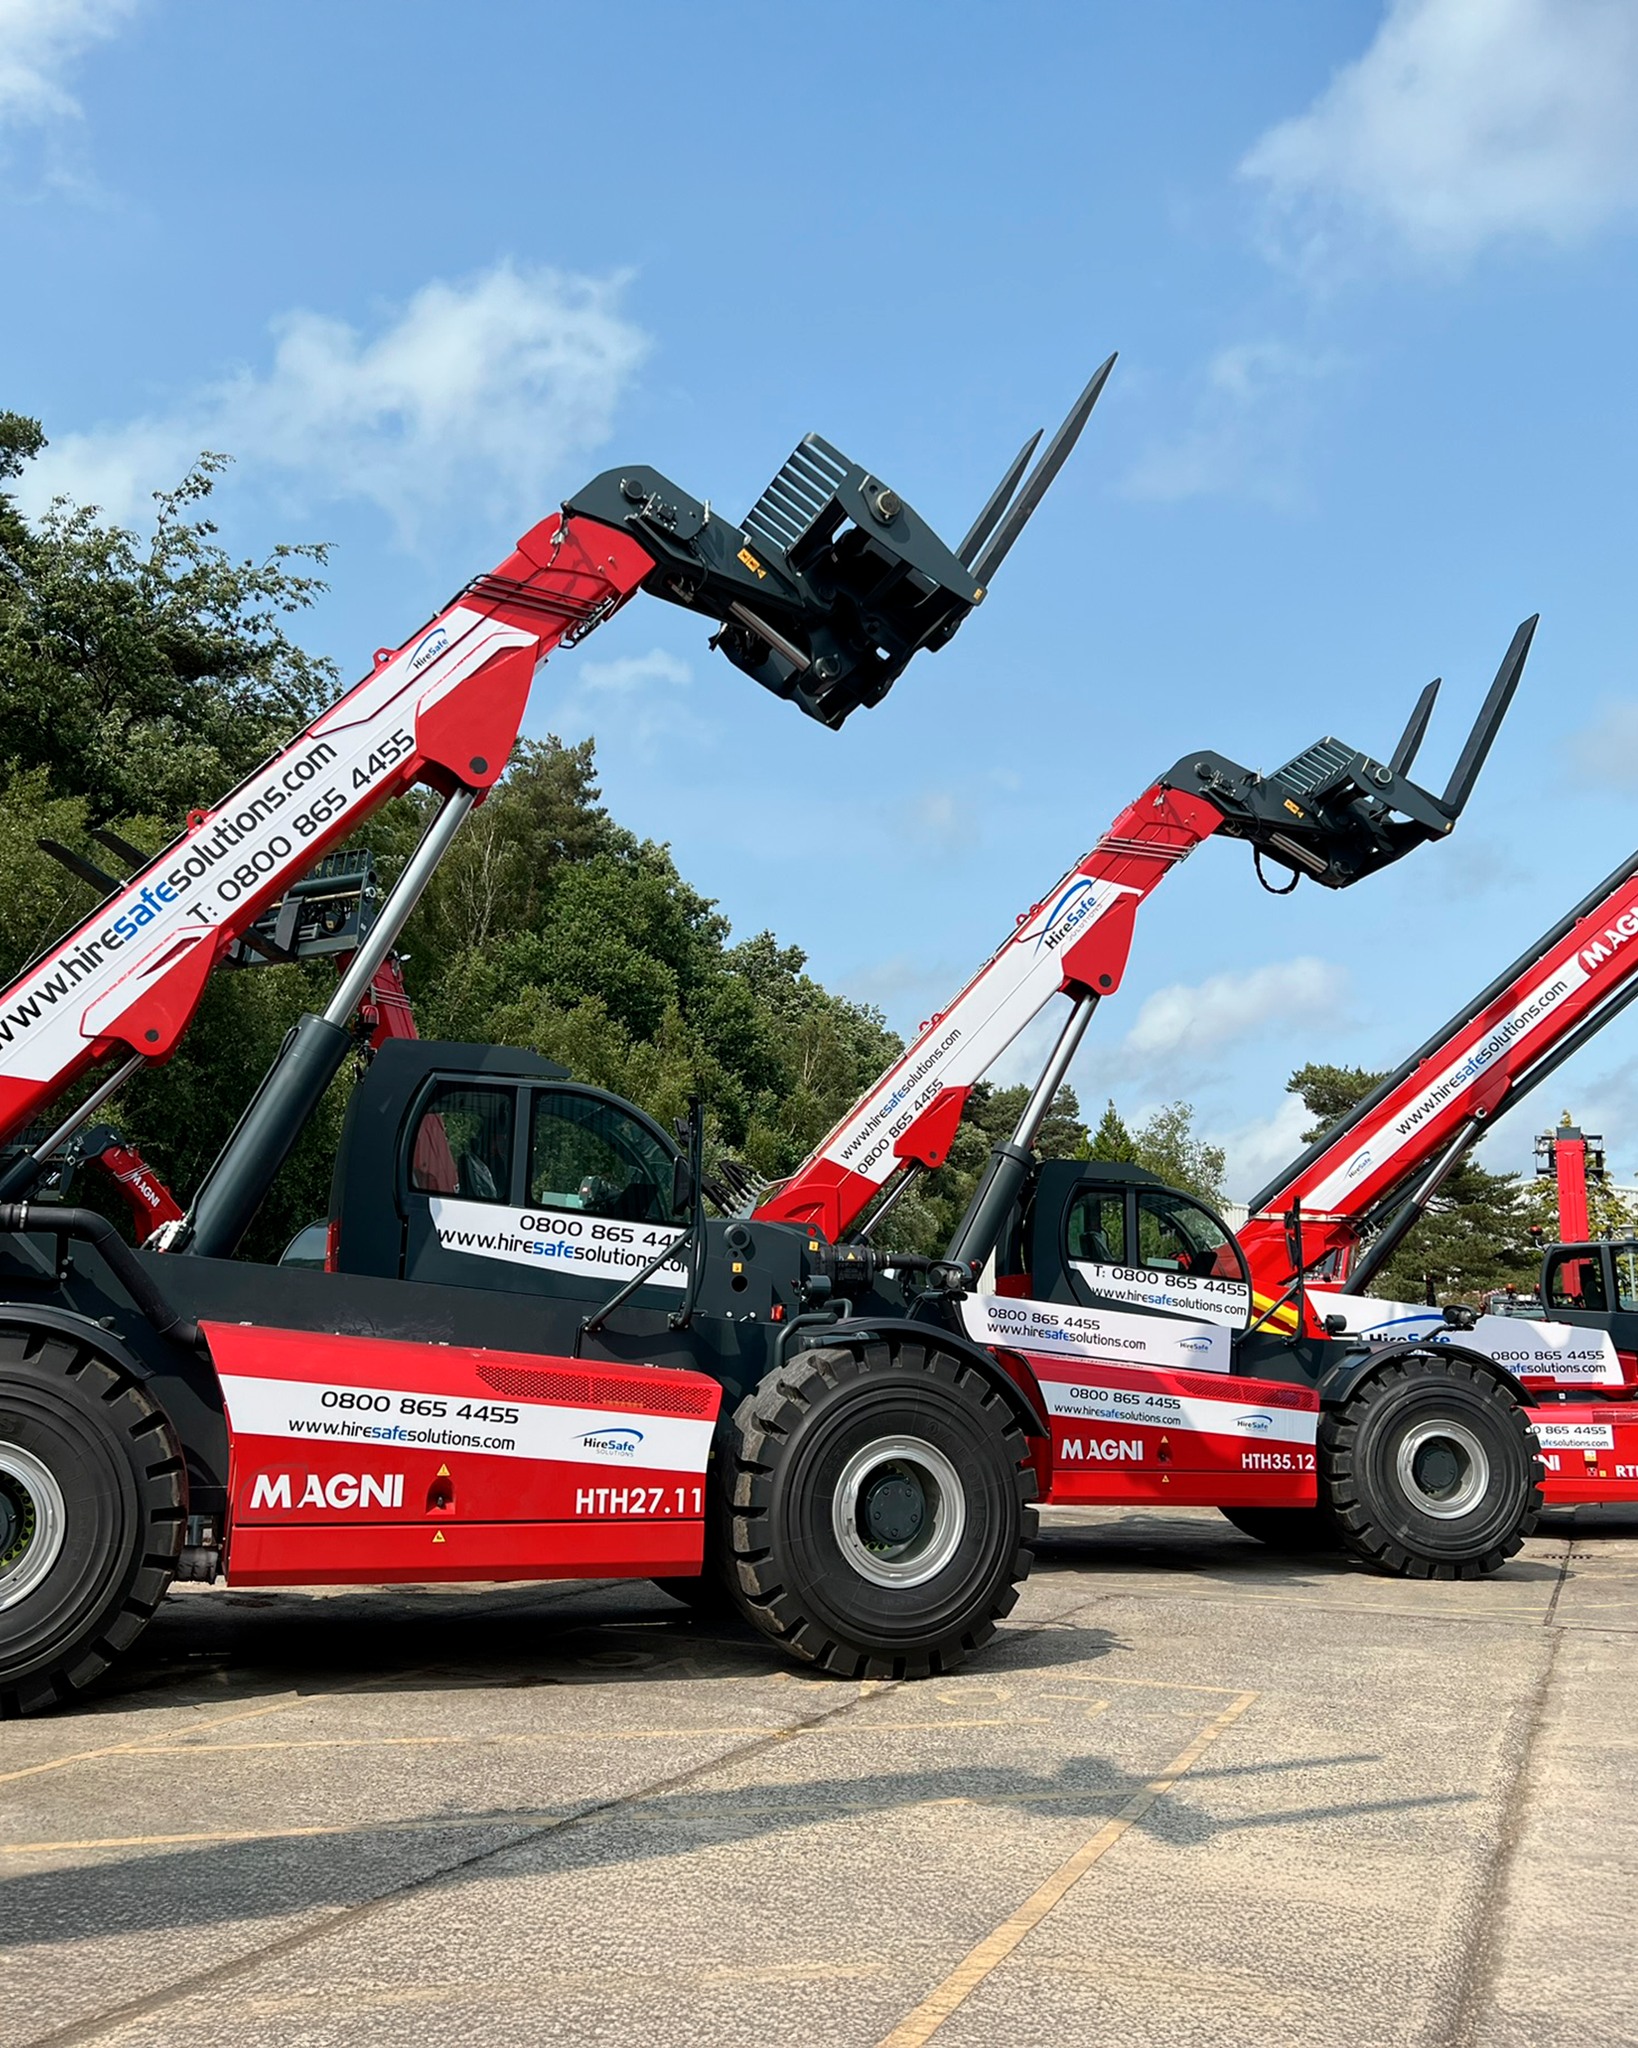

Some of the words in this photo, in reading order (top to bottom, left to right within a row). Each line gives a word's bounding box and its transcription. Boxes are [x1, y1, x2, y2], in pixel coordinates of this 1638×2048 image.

[413, 639, 449, 669] HireSafe
[186, 902, 218, 923] T:
[217, 836, 292, 901] 0800
[292, 787, 347, 837] 865
[352, 728, 414, 789] 4455
[1044, 897, 1097, 950] HireSafe
[1395, 980, 1568, 1135] www.hiresafesolutions.com
[840, 1029, 962, 1160] www.hiresafesolutions.com
[857, 1139, 890, 1174] 0800
[889, 1111, 914, 1139] 865
[914, 1078, 944, 1112] 4455
[132, 1172, 160, 1208] MAGNI
[520, 1215, 583, 1236] 0800
[591, 1225, 634, 1243] 865
[1093, 1265, 1106, 1278] T:
[1112, 1268, 1158, 1285] 0800
[1165, 1274, 1197, 1290] 865
[1204, 1281, 1247, 1297] 4455
[988, 1307, 1027, 1321] 0800
[1031, 1313, 1059, 1326] 865
[1063, 1317, 1100, 1331] 4455
[987, 1323, 1146, 1350] www.hiresafesolutions.com
[1179, 1341, 1209, 1350] HireSafe
[1491, 1351, 1530, 1361] 0800
[1534, 1351, 1562, 1361] 865
[1567, 1350, 1605, 1361] 4455
[321, 1391, 391, 1413] 0800
[399, 1398, 447, 1418] 865
[456, 1404, 520, 1425] 4455
[1069, 1387, 1109, 1401] 0800
[1113, 1392, 1140, 1405] 865
[1145, 1396, 1181, 1410] 4455
[1054, 1404, 1181, 1426] www.hiresafesolutions.com
[1237, 1420, 1268, 1430] HireSafe
[288, 1419, 516, 1451] www.hiresafesolutions.com
[583, 1437, 635, 1451] HireSafe
[1545, 1425, 1569, 1435] 865
[1574, 1426, 1607, 1435] 4455
[1061, 1438, 1144, 1461] MAGNI
[1241, 1453, 1315, 1470] HTH35.12
[249, 1473, 405, 1510] MAGNI
[575, 1487, 701, 1515] HTH27.11
